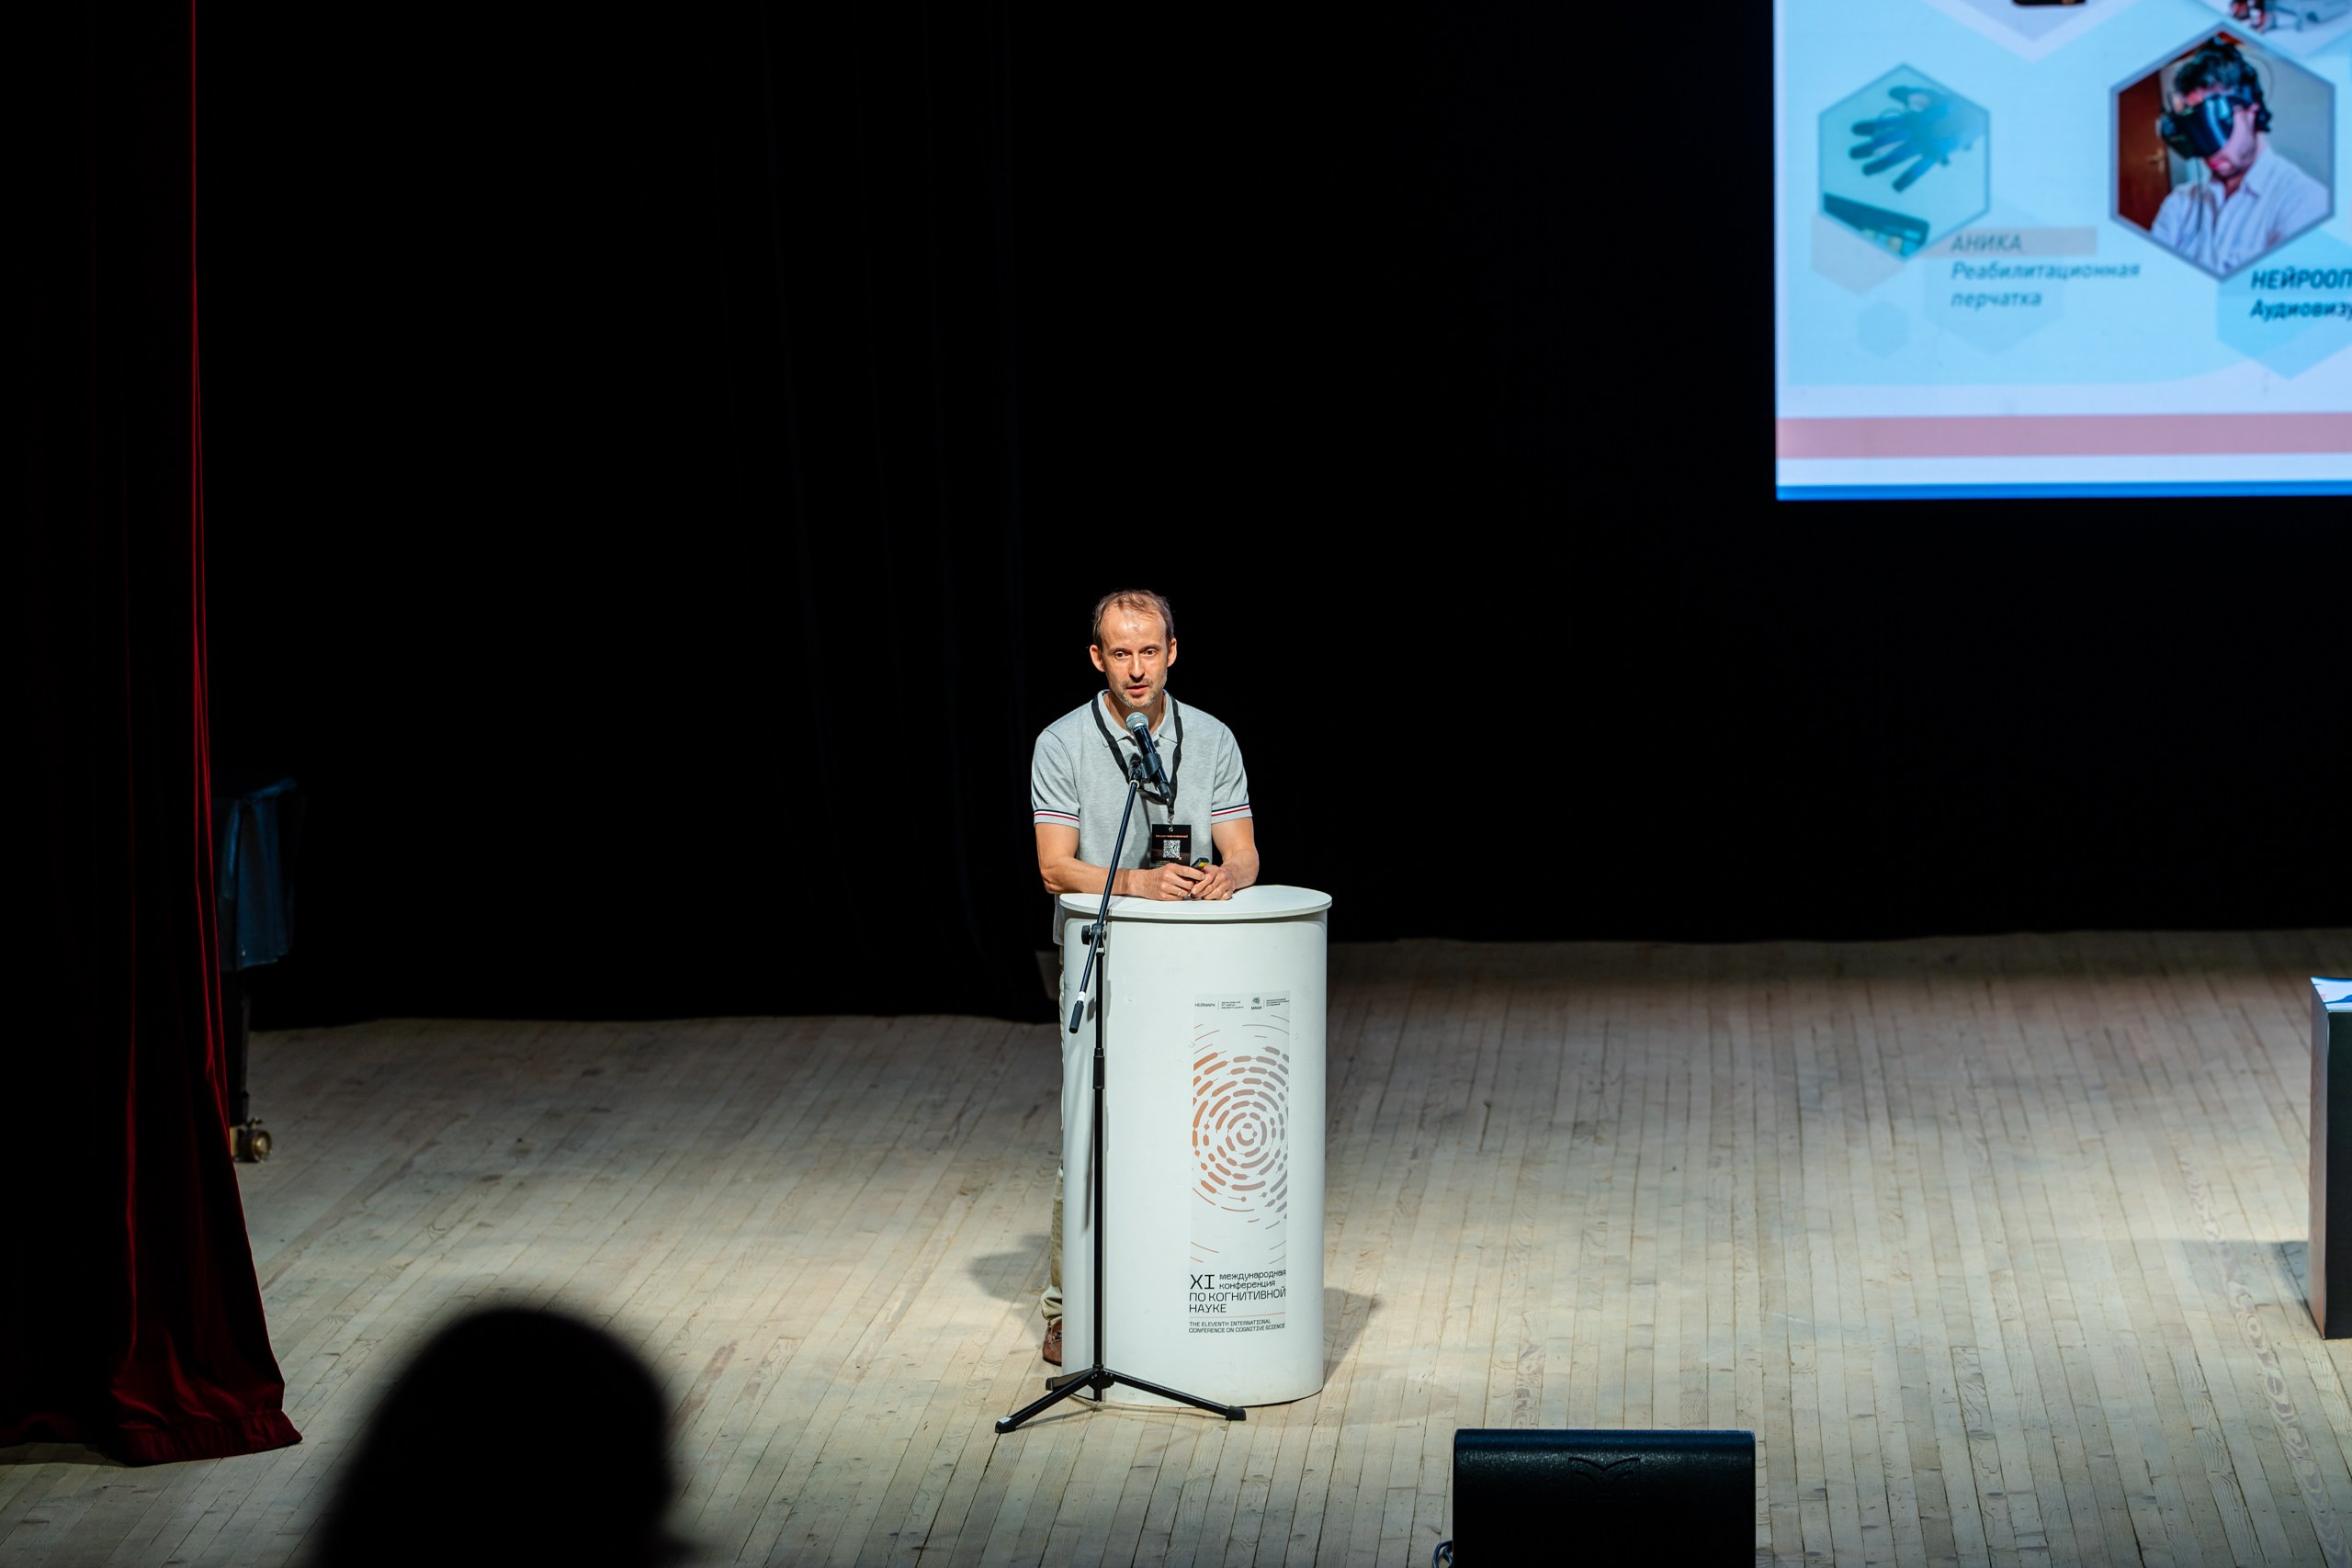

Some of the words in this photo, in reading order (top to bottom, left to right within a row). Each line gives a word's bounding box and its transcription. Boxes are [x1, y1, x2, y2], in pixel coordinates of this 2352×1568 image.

[1951, 234, 2022, 253] АНИКА
[1951, 262, 2141, 281] Реабилитационная
[1951, 291, 2042, 310] перчатка
[1190, 1274, 1215, 1290] XI
[1219, 1269, 1286, 1281] международная
[1219, 1280, 1276, 1291] конференция
[1189, 1292, 1206, 1302] ПО
[1209, 1286, 1286, 1302] КОГНИТИВНОЙ
[1189, 1303, 1227, 1314] НАУКЕ
